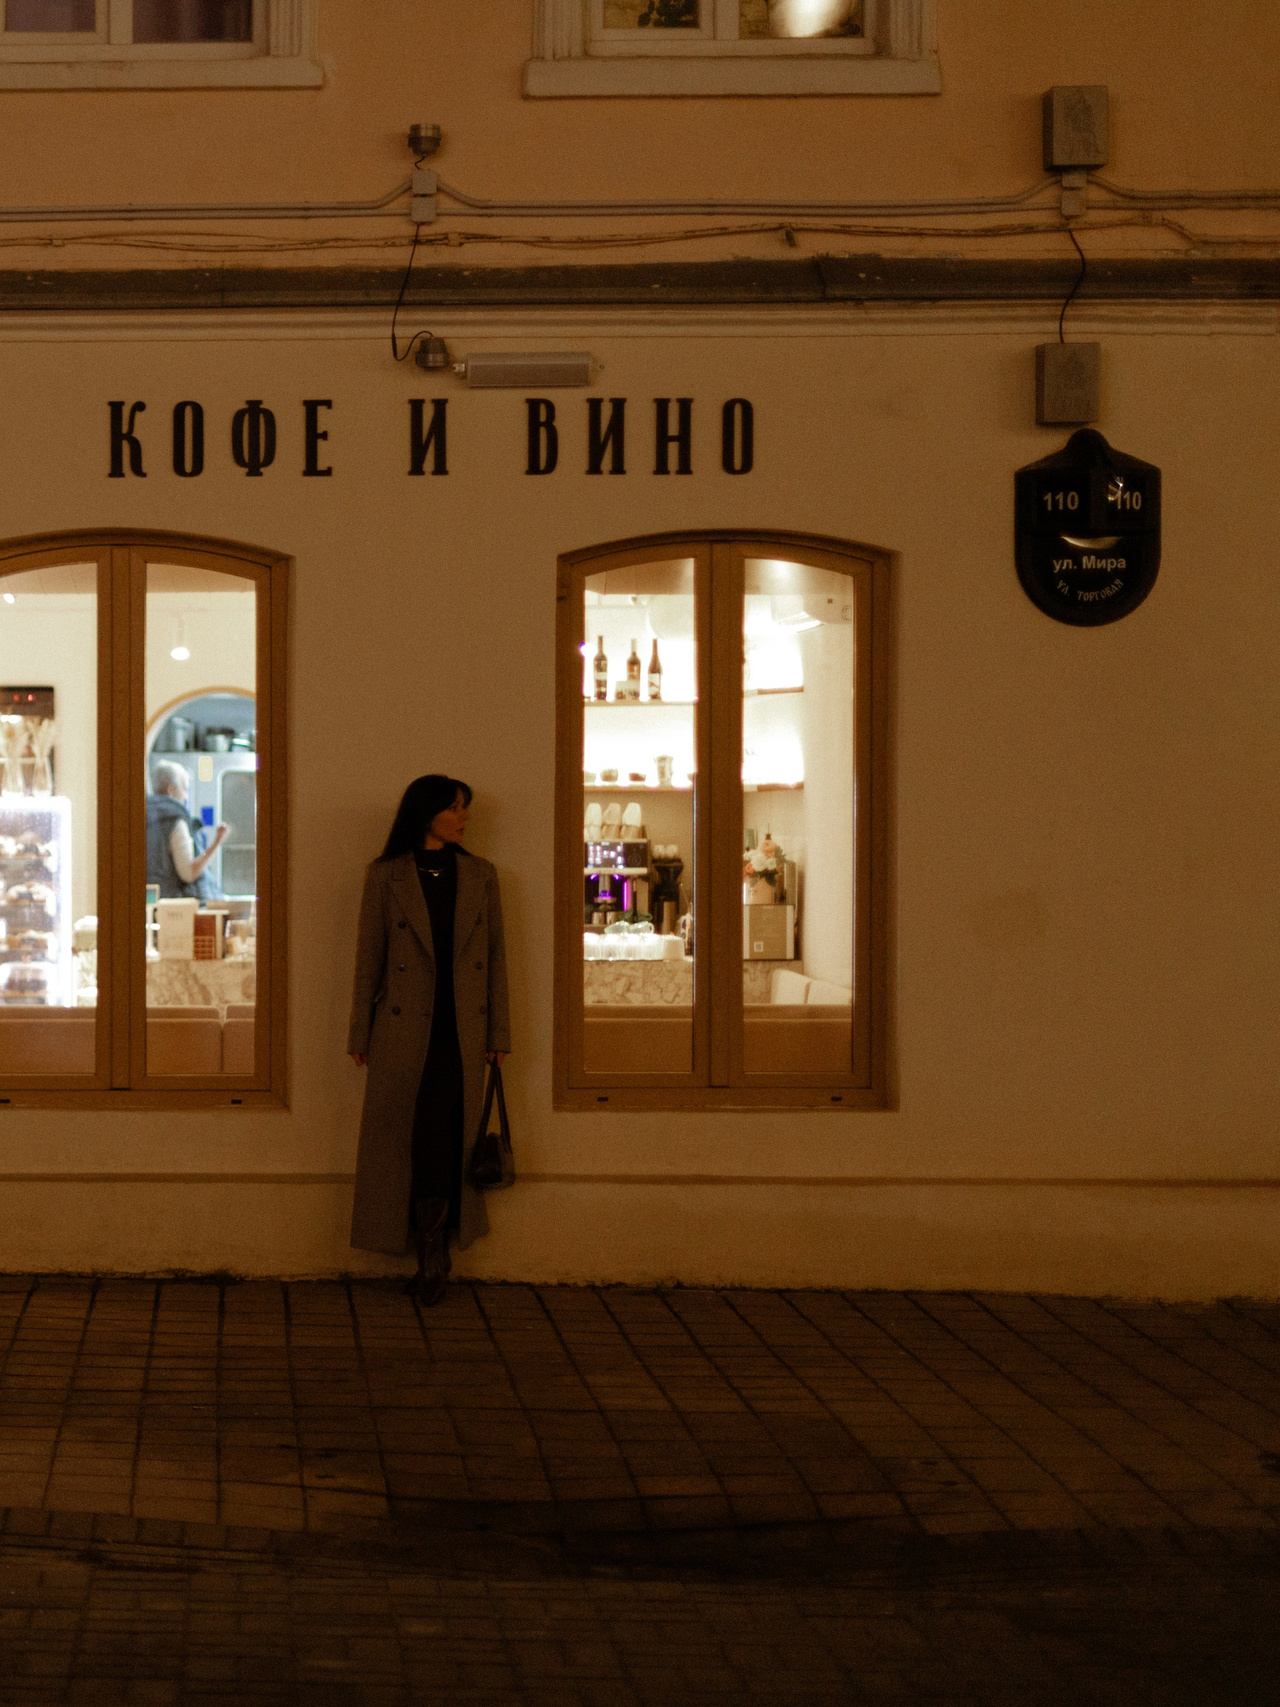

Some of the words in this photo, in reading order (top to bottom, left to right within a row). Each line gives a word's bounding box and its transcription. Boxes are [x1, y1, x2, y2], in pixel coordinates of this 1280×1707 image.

[107, 399, 333, 478] КОФЕ
[407, 398, 450, 476] И
[524, 397, 755, 476] ВИНО
[1043, 491, 1080, 511] 110
[1115, 491, 1142, 511] 110
[1052, 557, 1077, 573] ул.
[1082, 555, 1127, 572] Мира
[1077, 578, 1124, 602] ТОРГОВАЯ
